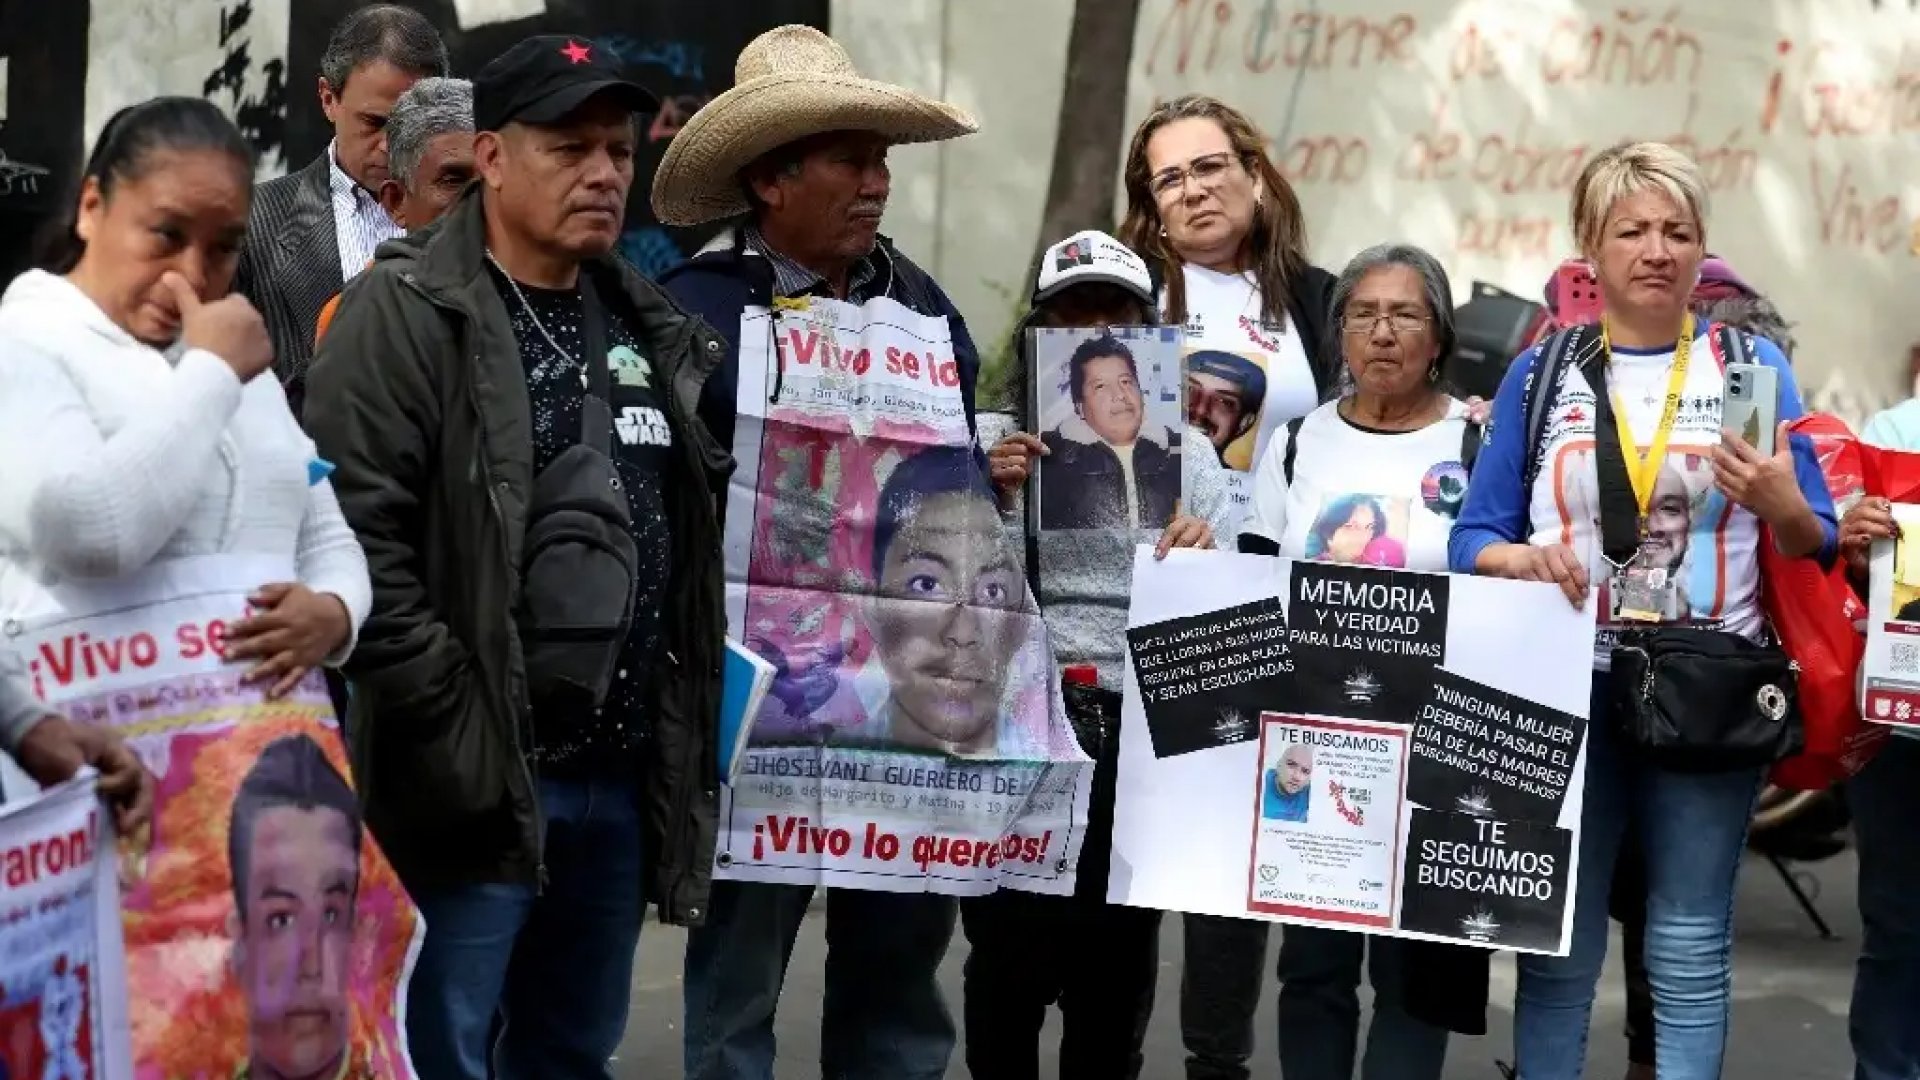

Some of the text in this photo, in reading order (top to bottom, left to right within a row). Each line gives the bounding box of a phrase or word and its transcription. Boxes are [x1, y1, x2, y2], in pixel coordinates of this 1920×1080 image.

[885, 344, 920, 380] se
[925, 351, 961, 388] lo
[615, 406, 667, 425] STAR
[616, 424, 672, 446] WARS
[1300, 577, 1436, 613] MEMORIA
[1315, 608, 1420, 635] Y VERDAD
[29, 630, 160, 702] ¡Vivo
[176, 619, 228, 661] se
[1139, 625, 1286, 669] QUE LLORAN A SUS HIJOS
[1289, 629, 1441, 658] PARA LAS VICTIMAS
[1143, 643, 1291, 686] RESUENE EN CADA PLAZA
[1145, 660, 1295, 704] Y SEAN ESCUCHADAS
[1280, 727, 1390, 753] TE BUSCAMOS
[1422, 704, 1570, 768] DEBERÍA PASAR EL
[1515, 713, 1574, 745] MUJER
[1413, 742, 1479, 774] BUSCANDO
[1479, 766, 1490, 778] A
[1491, 770, 1518, 787] SUS
[1416, 724, 1567, 787] DÍA DE LAS MADRES
[759, 782, 793, 798] Hijo
[993, 774, 1019, 796] DE
[3, 811, 98, 889] aron!
[753, 815, 1053, 873] ¡Vivo lo quereos!
[1473, 818, 1508, 845] TE
[1420, 839, 1555, 877] SEGUIMOS
[1417, 863, 1553, 901] BUSCANDO
